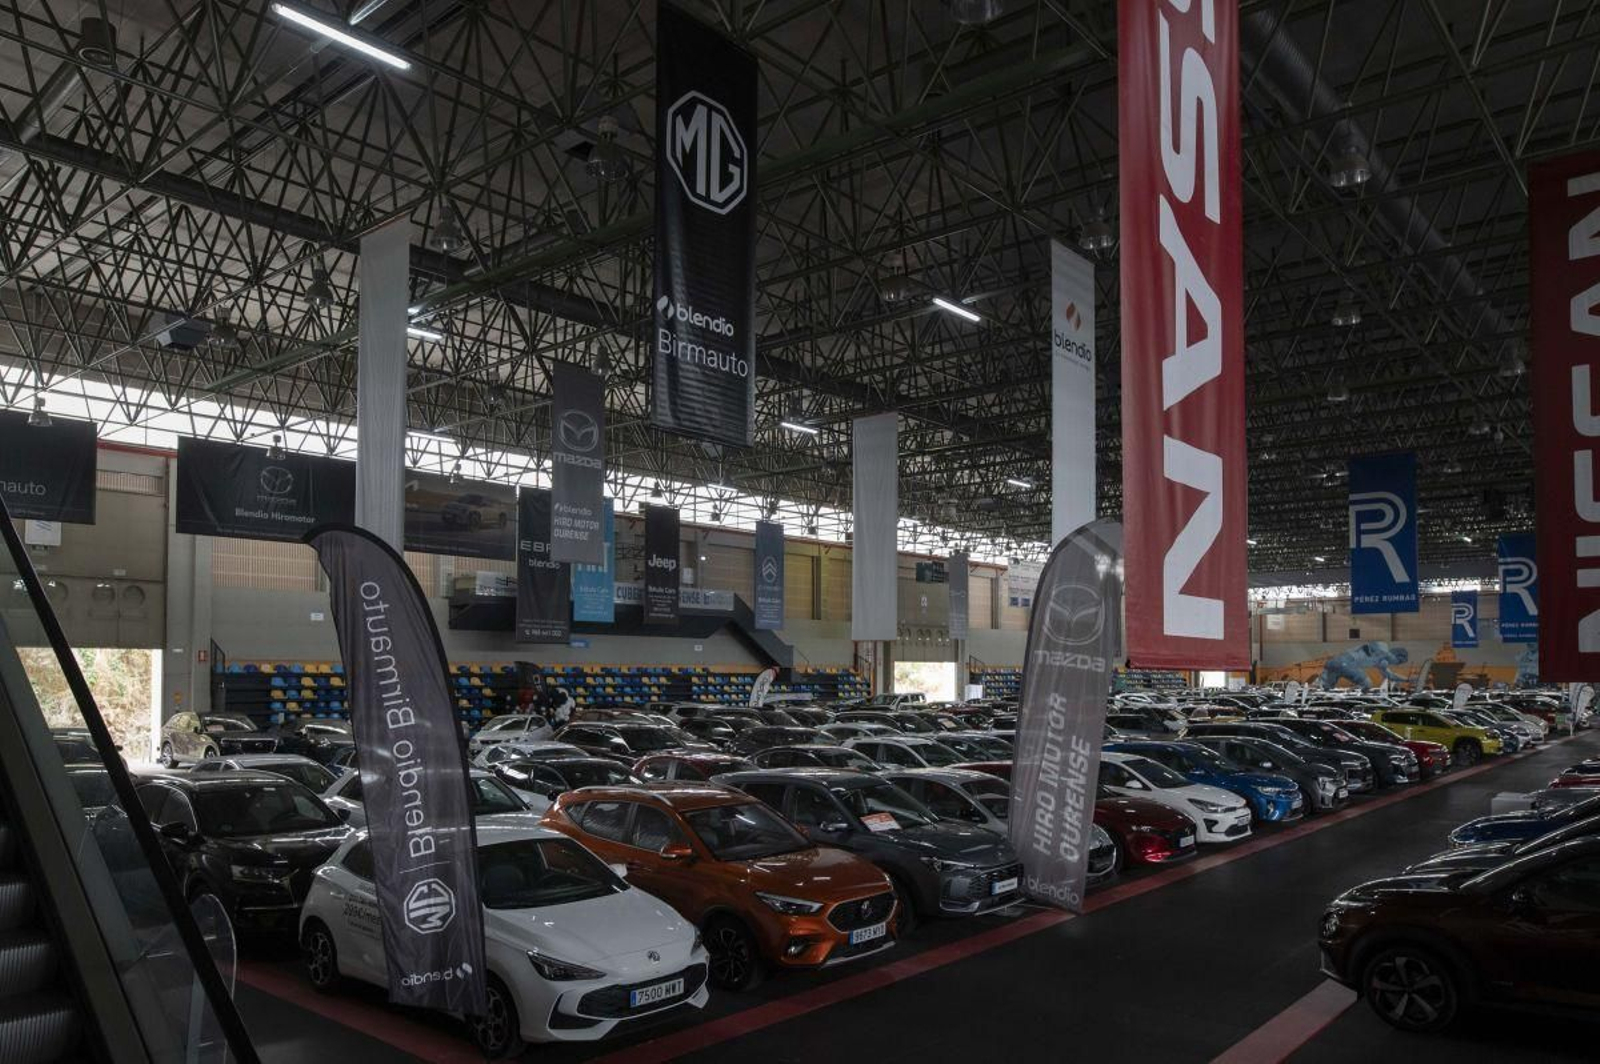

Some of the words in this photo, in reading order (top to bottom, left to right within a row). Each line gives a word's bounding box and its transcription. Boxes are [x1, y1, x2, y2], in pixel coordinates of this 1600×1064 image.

[672, 99, 743, 206] MG
[676, 302, 734, 337] blendio
[1158, 0, 1225, 640] SAN
[658, 328, 748, 378] Birmauto
[1053, 328, 1092, 361] blendio
[235, 507, 269, 519] Blendio
[271, 511, 316, 524] Hiromotor
[553, 516, 573, 527] HIRO
[573, 518, 600, 530] MOTOR
[563, 503, 592, 516] blendio
[553, 528, 590, 541] OURENSE
[648, 554, 677, 571] Jeep
[1034, 650, 1107, 673] mazda
[1038, 692, 1068, 788] MOTOR
[1059, 734, 1091, 864] OURENSE
[1032, 789, 1058, 857] HIRO
[1027, 875, 1080, 905] blendio
[638, 986, 663, 1004] 7500
